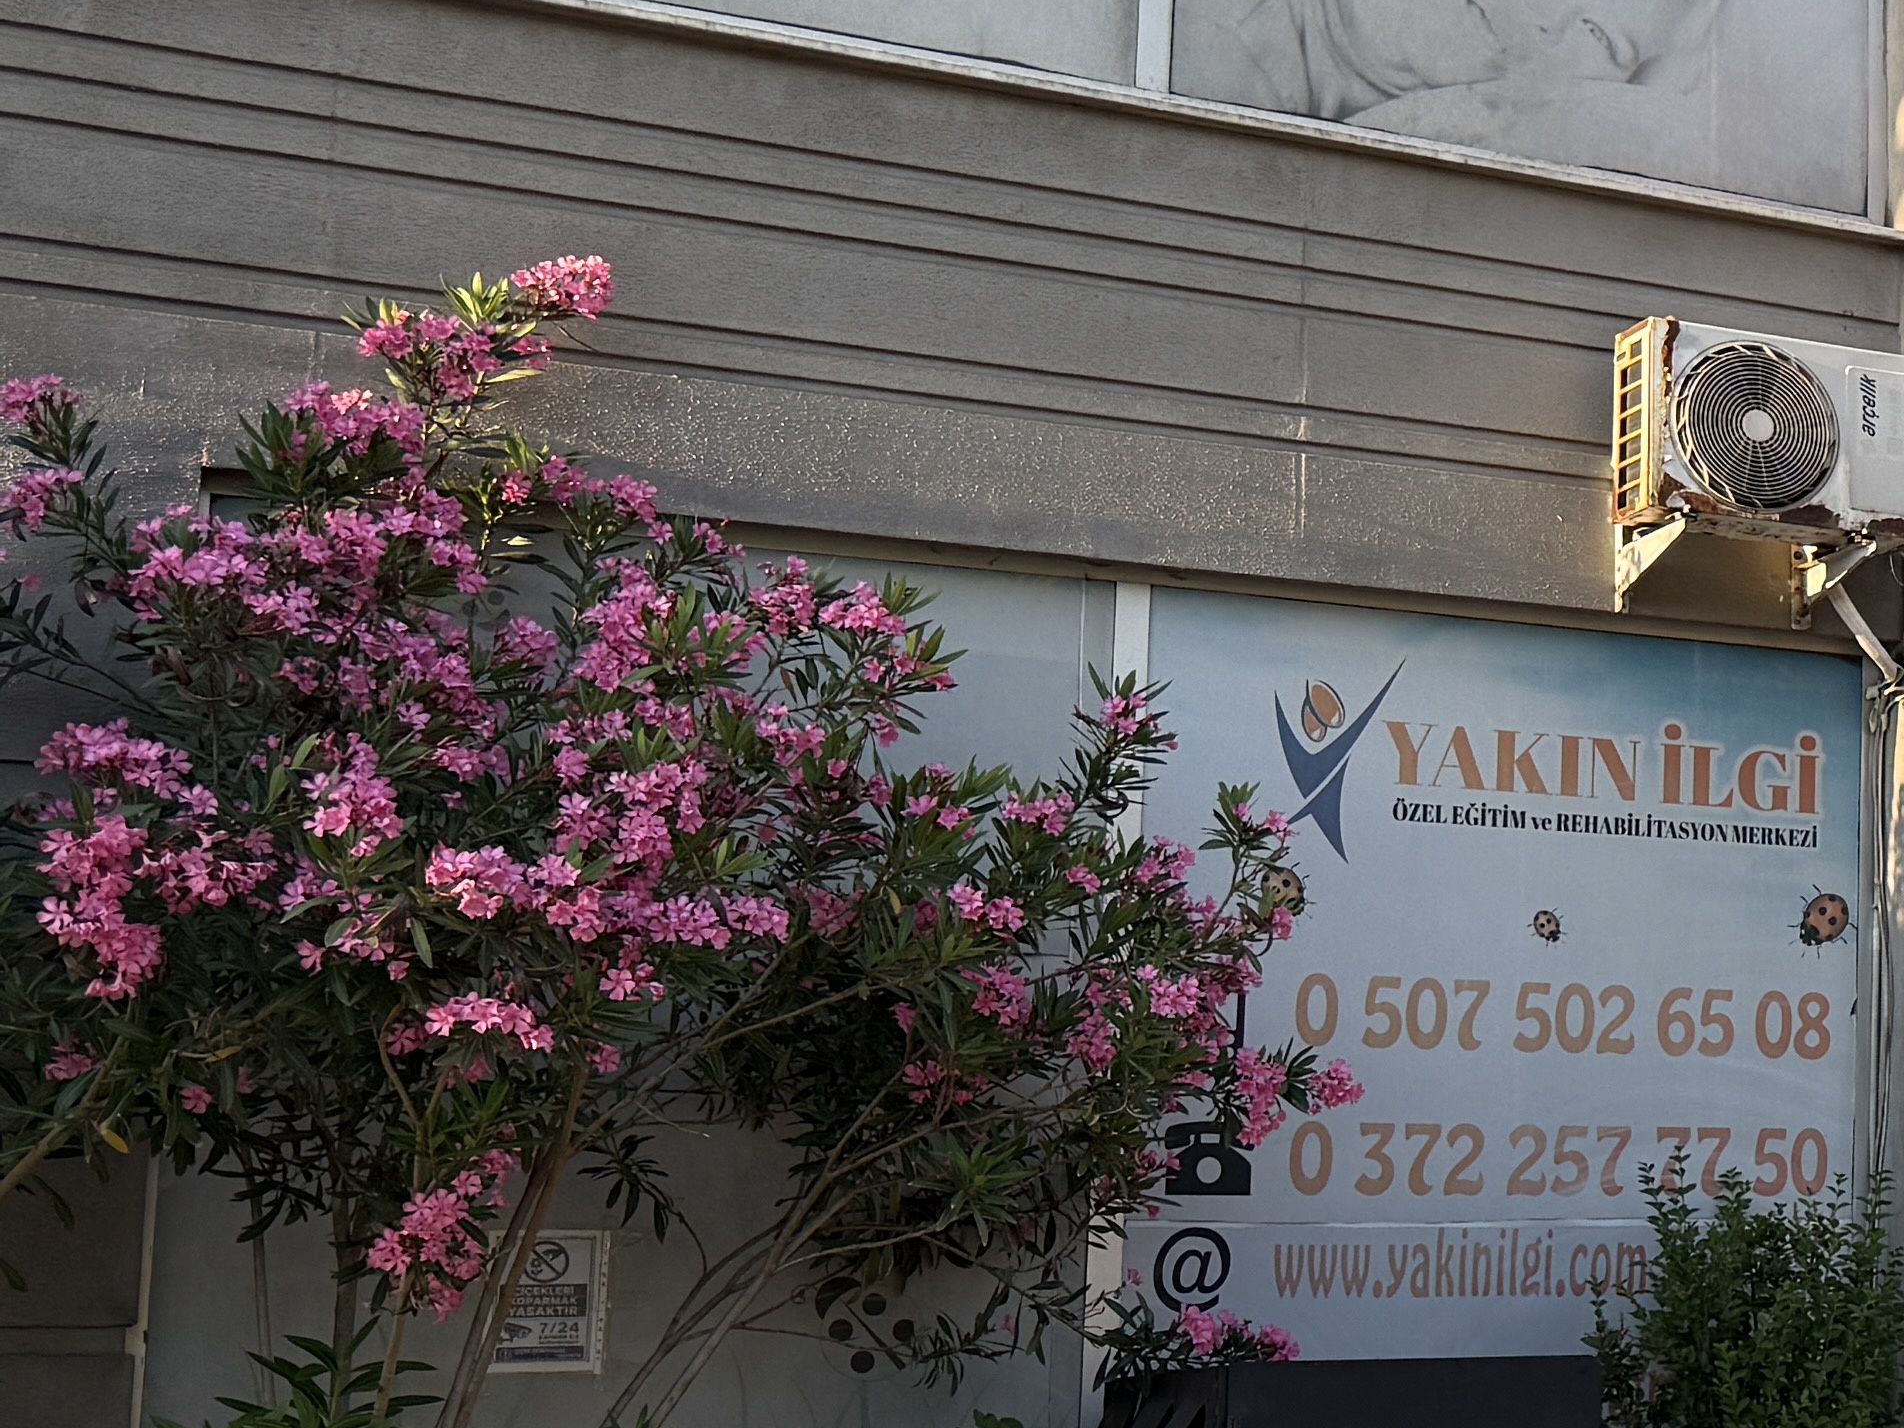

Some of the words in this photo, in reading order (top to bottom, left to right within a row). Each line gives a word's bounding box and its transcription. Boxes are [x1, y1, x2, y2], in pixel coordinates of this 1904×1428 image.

[1860, 374, 1879, 437] arçelik
[1382, 720, 1641, 801] YAKIN
[1660, 723, 1820, 814] İLGİ
[1393, 798, 1447, 824] ÖZEL
[1451, 802, 1526, 830] EĞİTİM
[1531, 816, 1552, 831] ve
[1556, 813, 1728, 842] REHABİLİTASYON
[1731, 825, 1818, 848] MERKEZİ
[1296, 973, 1339, 1047] 0
[1361, 975, 1490, 1051] 507
[1513, 982, 1635, 1054] 502
[1657, 987, 1734, 1057] 65
[1755, 990, 1831, 1060] 08
[1289, 1121, 1333, 1196] 0
[1355, 1122, 1485, 1197] 372
[1506, 1124, 1632, 1197] 257
[1656, 1127, 1732, 1197] 77
[1752, 1128, 1828, 1197] 50
[516, 1286, 574, 1295] İÇEKLERİ
[1273, 1227, 1648, 1299] www.yakinilgi.com
[510, 1306, 577, 1316] YASAKTIR
[540, 1322, 579, 1333] 7/24
